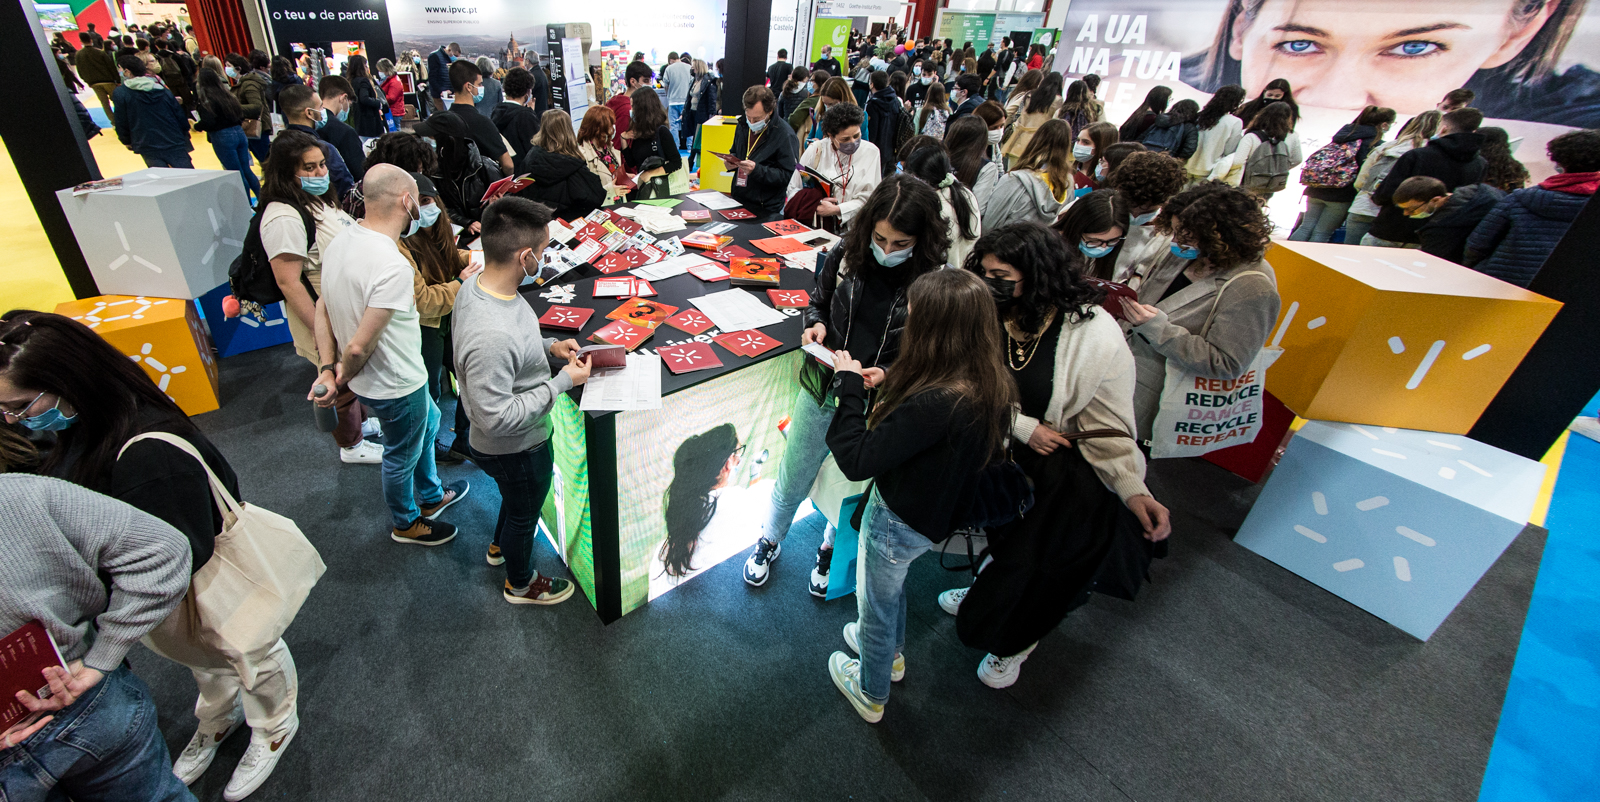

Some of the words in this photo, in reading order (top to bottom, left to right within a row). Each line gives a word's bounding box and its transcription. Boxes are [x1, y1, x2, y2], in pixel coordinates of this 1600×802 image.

[273, 12, 281, 20] o
[285, 11, 305, 20] teu
[320, 10, 335, 20] de
[338, 10, 379, 22] partida
[425, 6, 478, 16] www.ipvc.pt
[1076, 14, 1098, 42] A
[1104, 14, 1148, 45] UA
[1068, 46, 1110, 76] NA
[1120, 49, 1182, 81] TUA
[1194, 370, 1256, 392] REUSE
[1185, 385, 1260, 408] REDUCE
[1187, 400, 1252, 422] DANCE
[1174, 413, 1257, 434] RECYCLE
[1176, 426, 1251, 446] REPEAT
